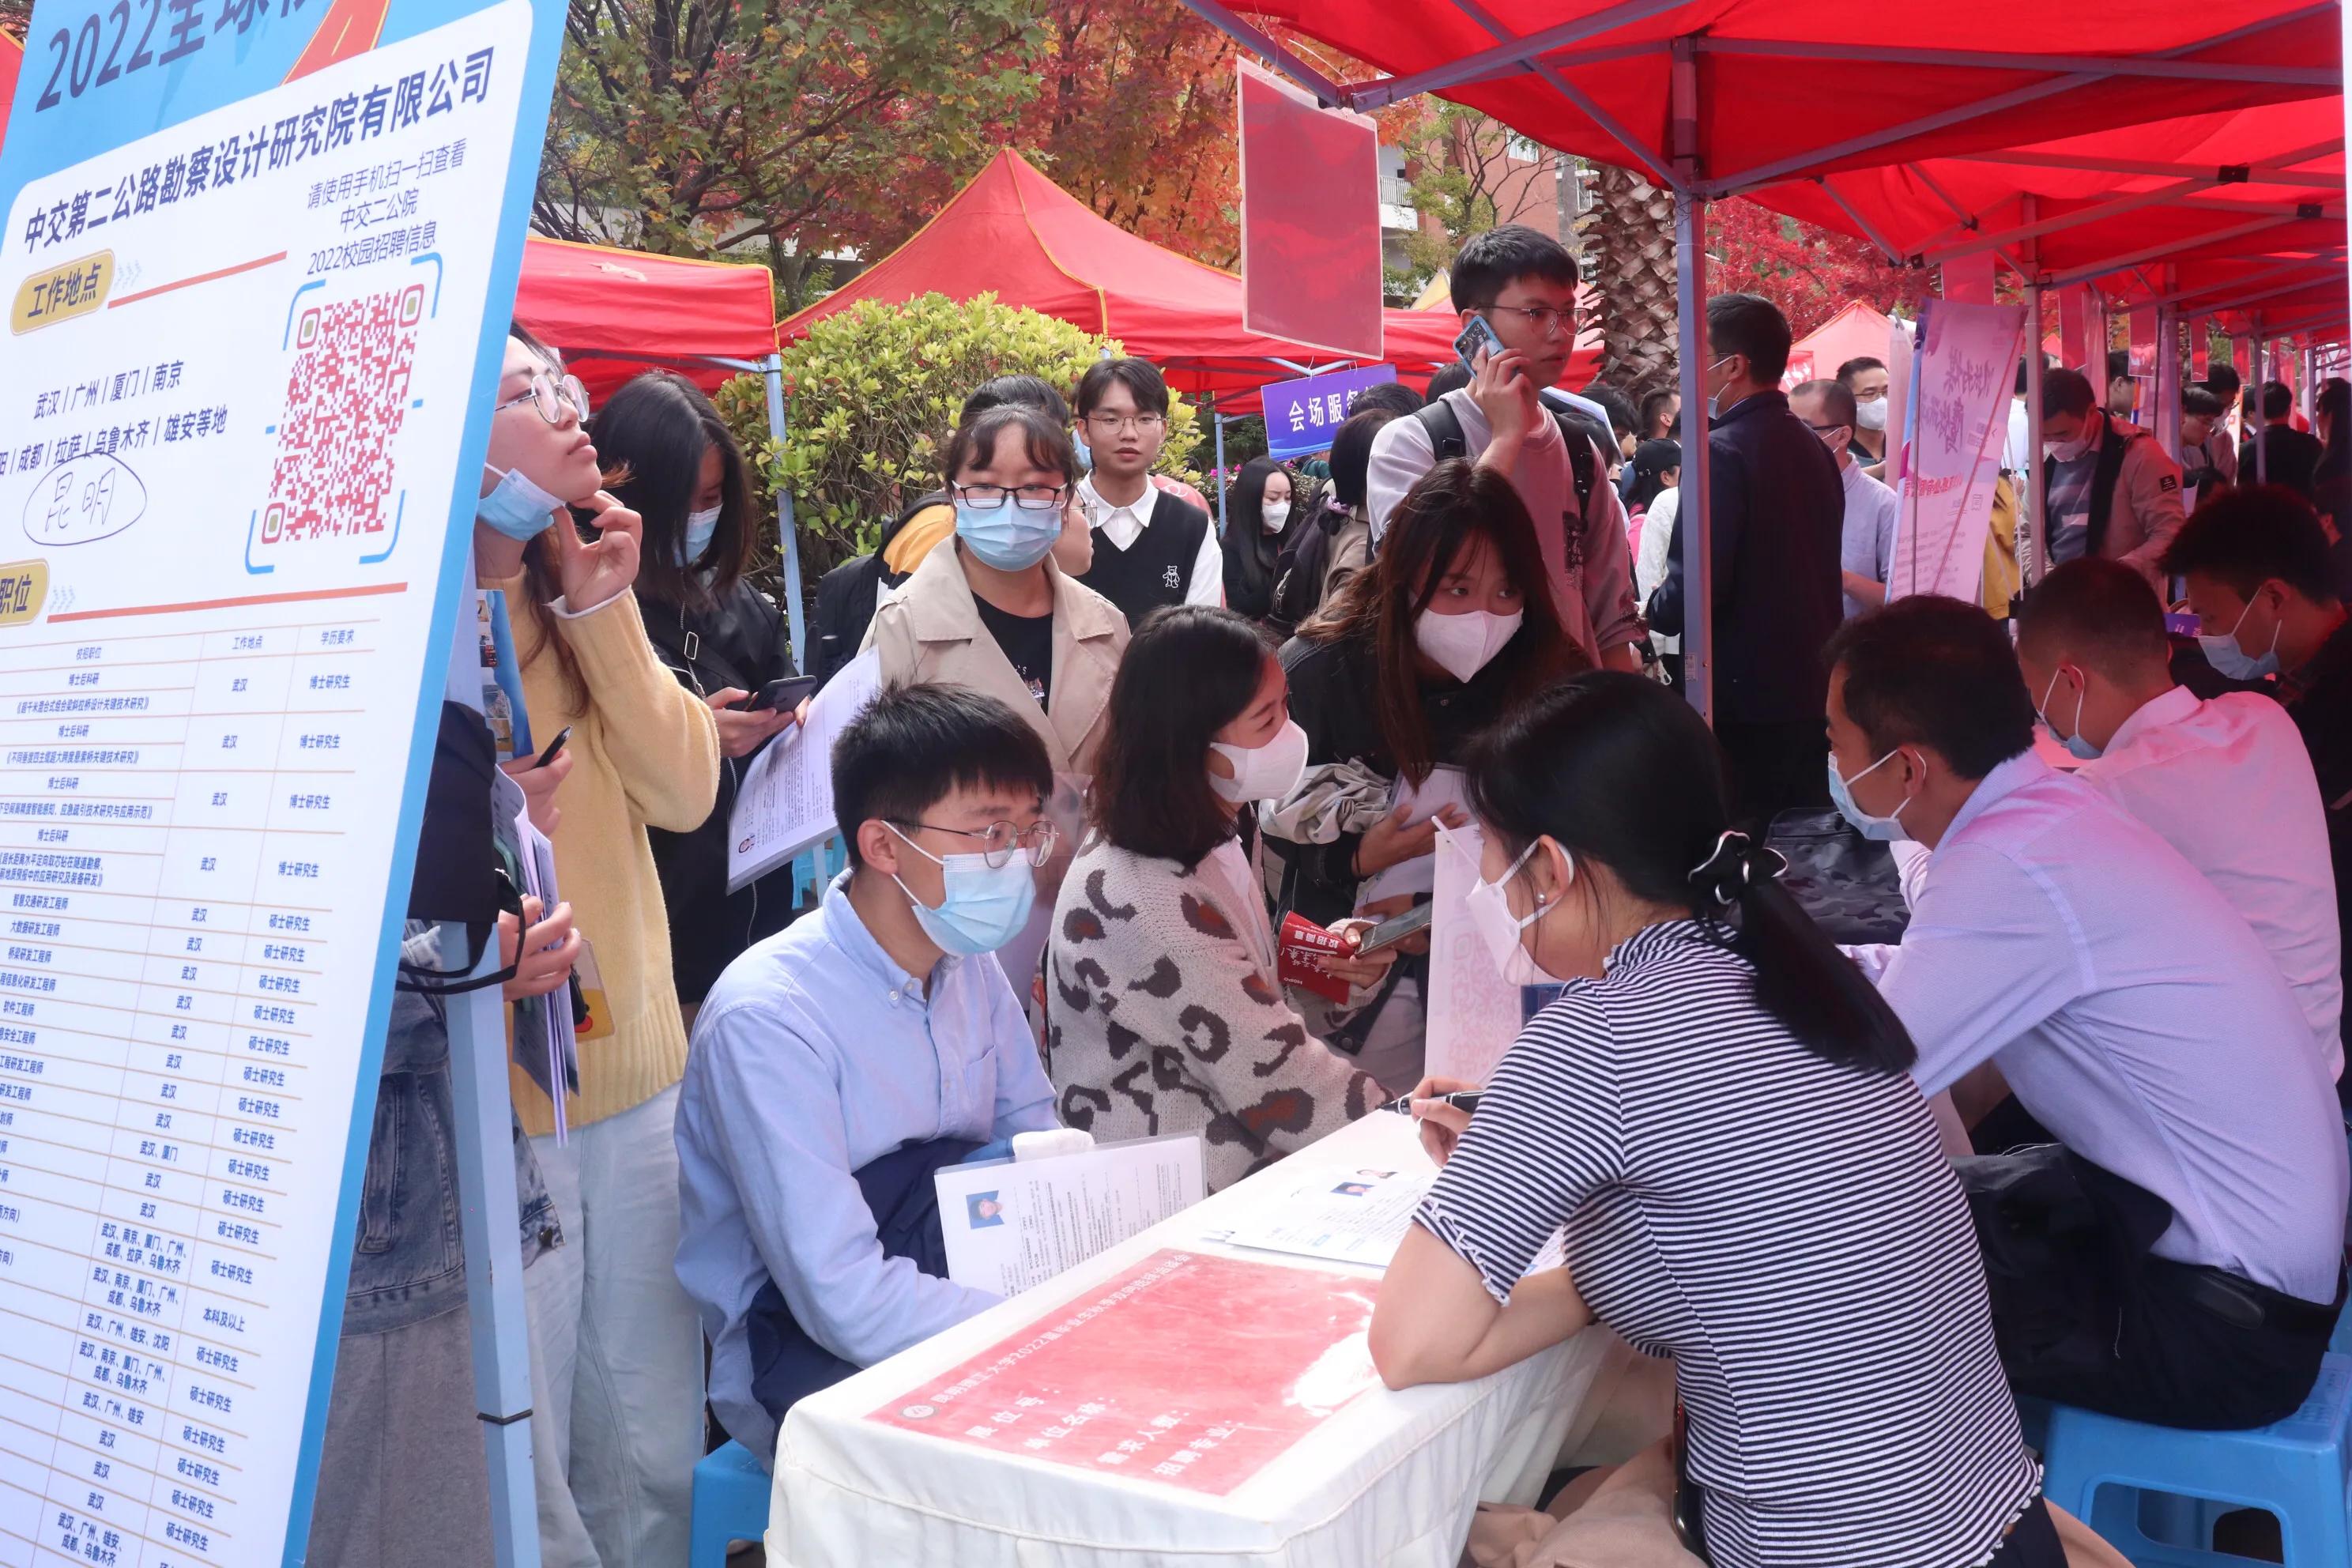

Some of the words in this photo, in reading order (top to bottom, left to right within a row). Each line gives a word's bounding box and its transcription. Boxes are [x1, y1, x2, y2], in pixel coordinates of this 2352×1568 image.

[24, 46, 494, 254] 中交第二公路勘察设计研究院有限公司
[307, 137, 466, 211] 请使用手机扫一扫查看
[338, 187, 419, 234] 中交二公院
[307, 220, 437, 276] 2022校园招聘信息
[28, 264, 102, 317] 工作地点
[45, 467, 116, 532] 昆明
[232, 636, 262, 649] 工作地点
[322, 629, 355, 645] 学历要求
[69, 673, 100, 686] 博士后科研
[232, 678, 248, 692] 武汉
[310, 675, 350, 689] 博士研究生
[58, 725, 89, 737] 博士后科研
[222, 735, 238, 749] 武汉
[300, 734, 340, 749] 博士研究生
[48, 777, 79, 790] 博士后科研
[212, 792, 228, 806] 武汉
[290, 794, 330, 809] 博士研究生
[37, 830, 69, 842] 博士后科研
[202, 857, 216, 872] 武汉
[278, 861, 318, 878] 博士研究生
[191, 907, 207, 922] 武汉
[269, 914, 311, 931] 硕士研究生
[187, 937, 202, 952] 武汉
[264, 944, 304, 962] 硕士研究生
[182, 966, 197, 981] 武汉
[258, 974, 300, 993] 硕士研究生
[3, 1001, 35, 1016] 软件工程师
[176, 995, 192, 1010] 武汉
[253, 1004, 295, 1025] 硕士研究生
[172, 1024, 187, 1040] 武汉
[248, 1035, 290, 1056] 硕士研究生
[166, 1054, 182, 1069] 武汉
[243, 1066, 285, 1087] 硕士研究生
[160, 1083, 177, 1099] 武汉
[238, 1097, 279, 1118] 硕士研究生
[155, 1113, 171, 1129] 武汉
[233, 1128, 274, 1150] 硕士研究生
[139, 1140, 178, 1161] 武汉、厦门
[228, 1159, 270, 1182] 硕士研究生
[145, 1173, 161, 1189] 武汉
[140, 1202, 156, 1218] 武汉
[222, 1189, 265, 1213] 硕士研究生
[217, 1220, 260, 1245] 硕士研究生
[104, 1242, 181, 1275] 成都、拉萨、乌鲁木齐
[210, 1259, 254, 1285] 硕士研究生
[107, 1290, 162, 1317] 成都、乌鲁木齐
[203, 1307, 244, 1332] 本科及以上
[85, 1312, 171, 1351] 武汉、广州、雄安、沈阳
[196, 1346, 239, 1373] 硕士研究生
[93, 1365, 148, 1395] 成都、乌鲁木齐
[83, 1392, 145, 1425] 武汉、广州、雄安
[190, 1385, 232, 1413] 硕士研究生
[100, 1430, 115, 1447] 武汉
[183, 1425, 225, 1453] 硕士研究生
[93, 1461, 110, 1479] 武汉
[177, 1457, 220, 1487] 硕士研究生
[89, 1491, 104, 1510] 武汉
[171, 1489, 214, 1519] 硕士研究生
[165, 1521, 209, 1551] 硕士研究生
[62, 1533, 116, 1567] 成都、乌鲁木齐
